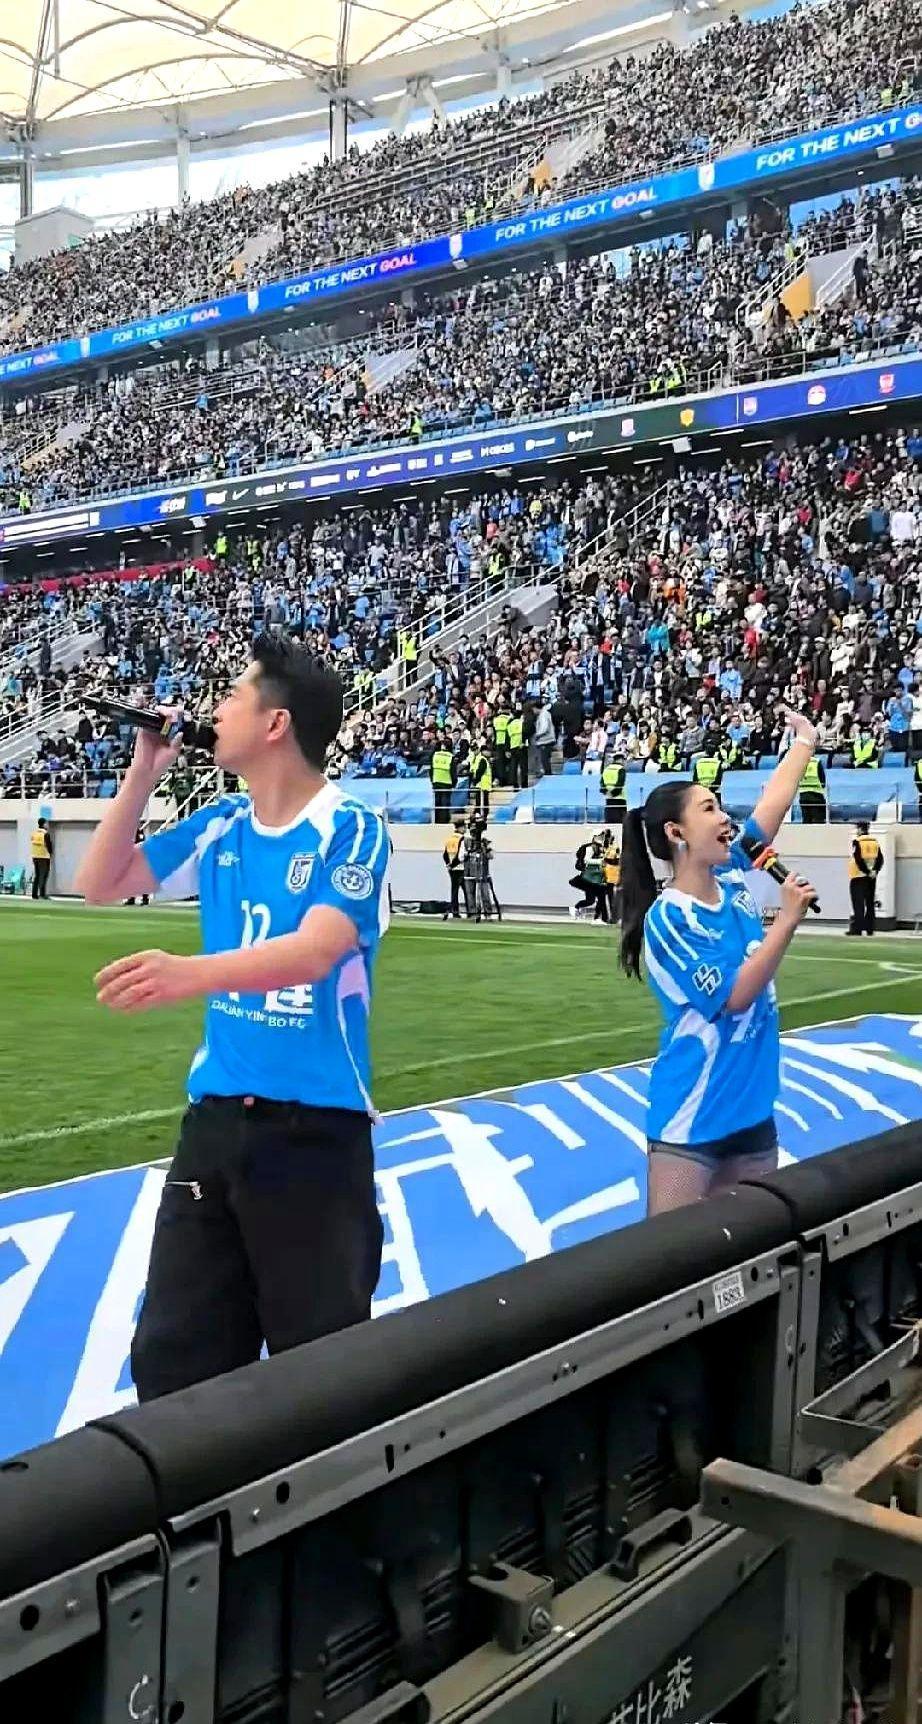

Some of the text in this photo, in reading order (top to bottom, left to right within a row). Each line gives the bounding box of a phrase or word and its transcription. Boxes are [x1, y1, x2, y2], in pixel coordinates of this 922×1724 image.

[756, 147, 796, 171] FOR
[801, 134, 840, 157] THE
[844, 117, 900, 147] NEXT
[495, 187, 657, 241] FOR THE NEXT GOAL
[284, 254, 416, 299] FOR THE NEXT GOAL
[112, 307, 220, 344] FOR THE NEXT GOAL
[7, 357, 32, 371] NEXT
[268, 1015, 287, 1028] BO
[289, 1017, 307, 1029] FC
[609, 1655, 693, 1724] 比森
